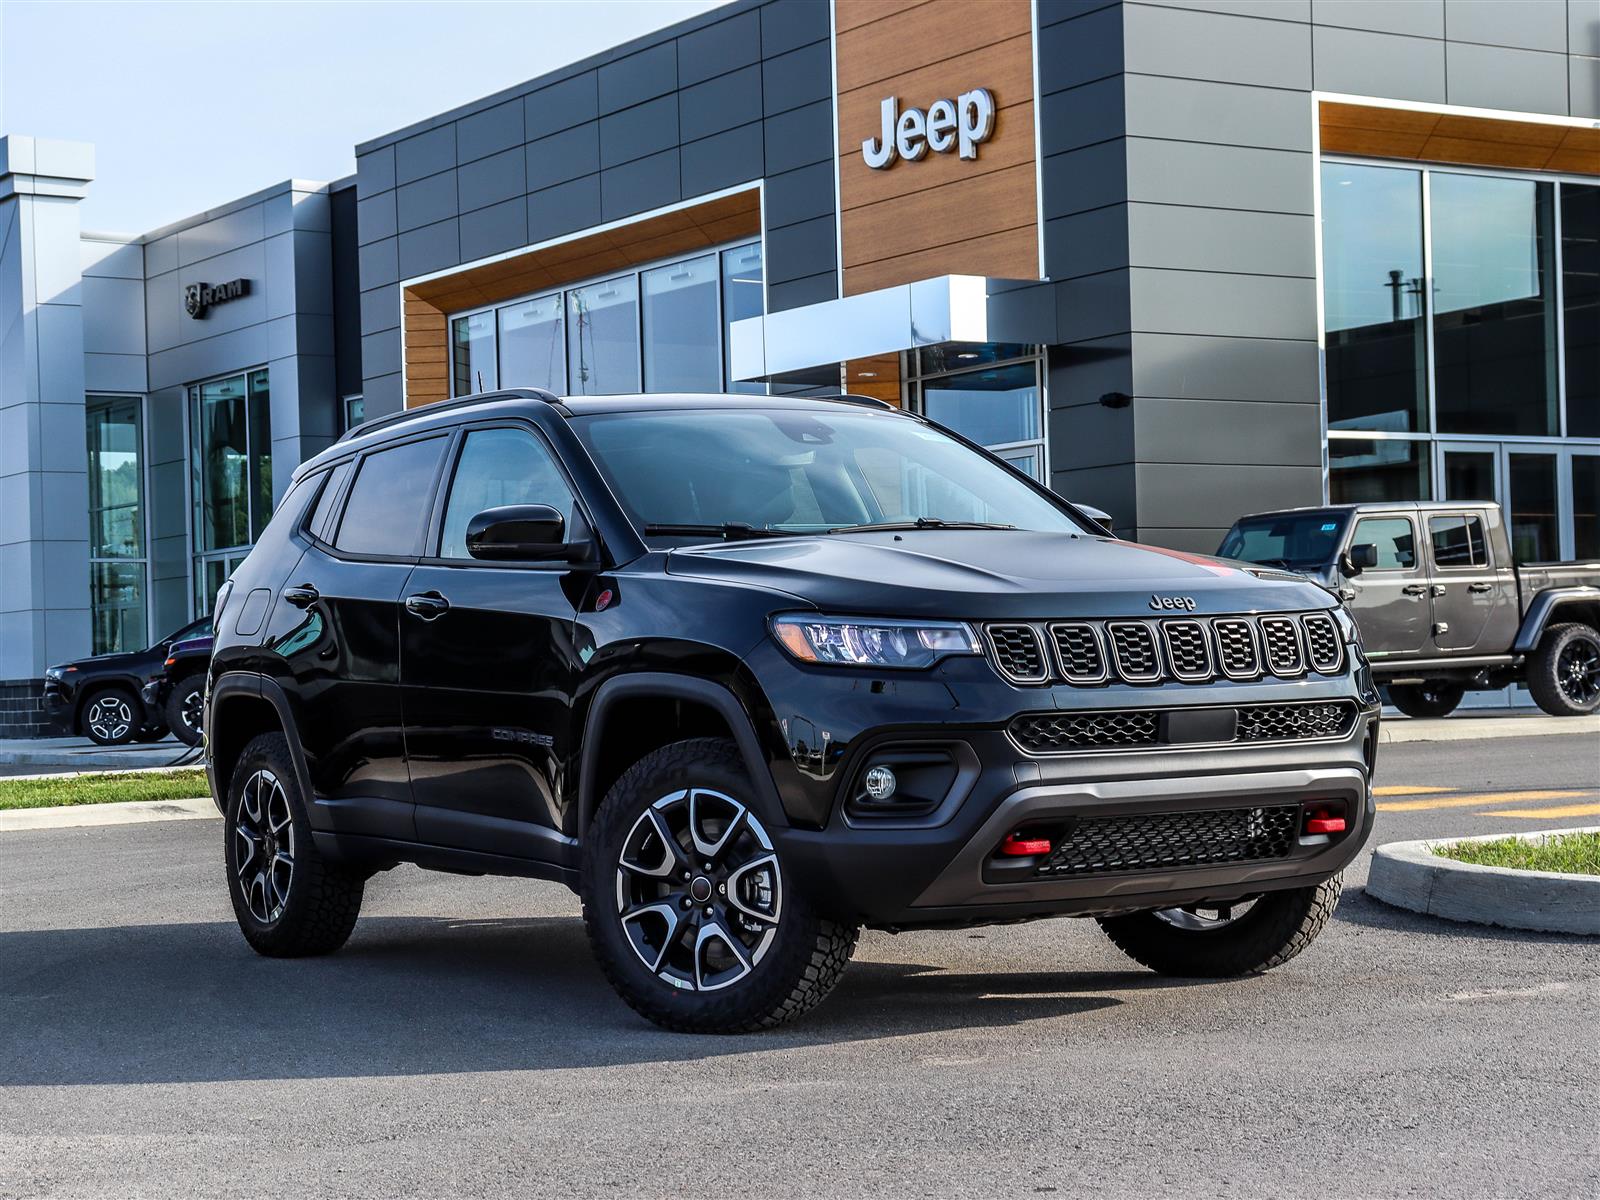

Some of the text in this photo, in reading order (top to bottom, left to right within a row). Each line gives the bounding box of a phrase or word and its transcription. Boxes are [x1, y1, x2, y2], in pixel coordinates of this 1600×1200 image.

[862, 87, 995, 169] Jeep
[202, 279, 245, 306] RAM
[1148, 594, 1196, 612] Jeep
[492, 728, 554, 747] COMPASS
